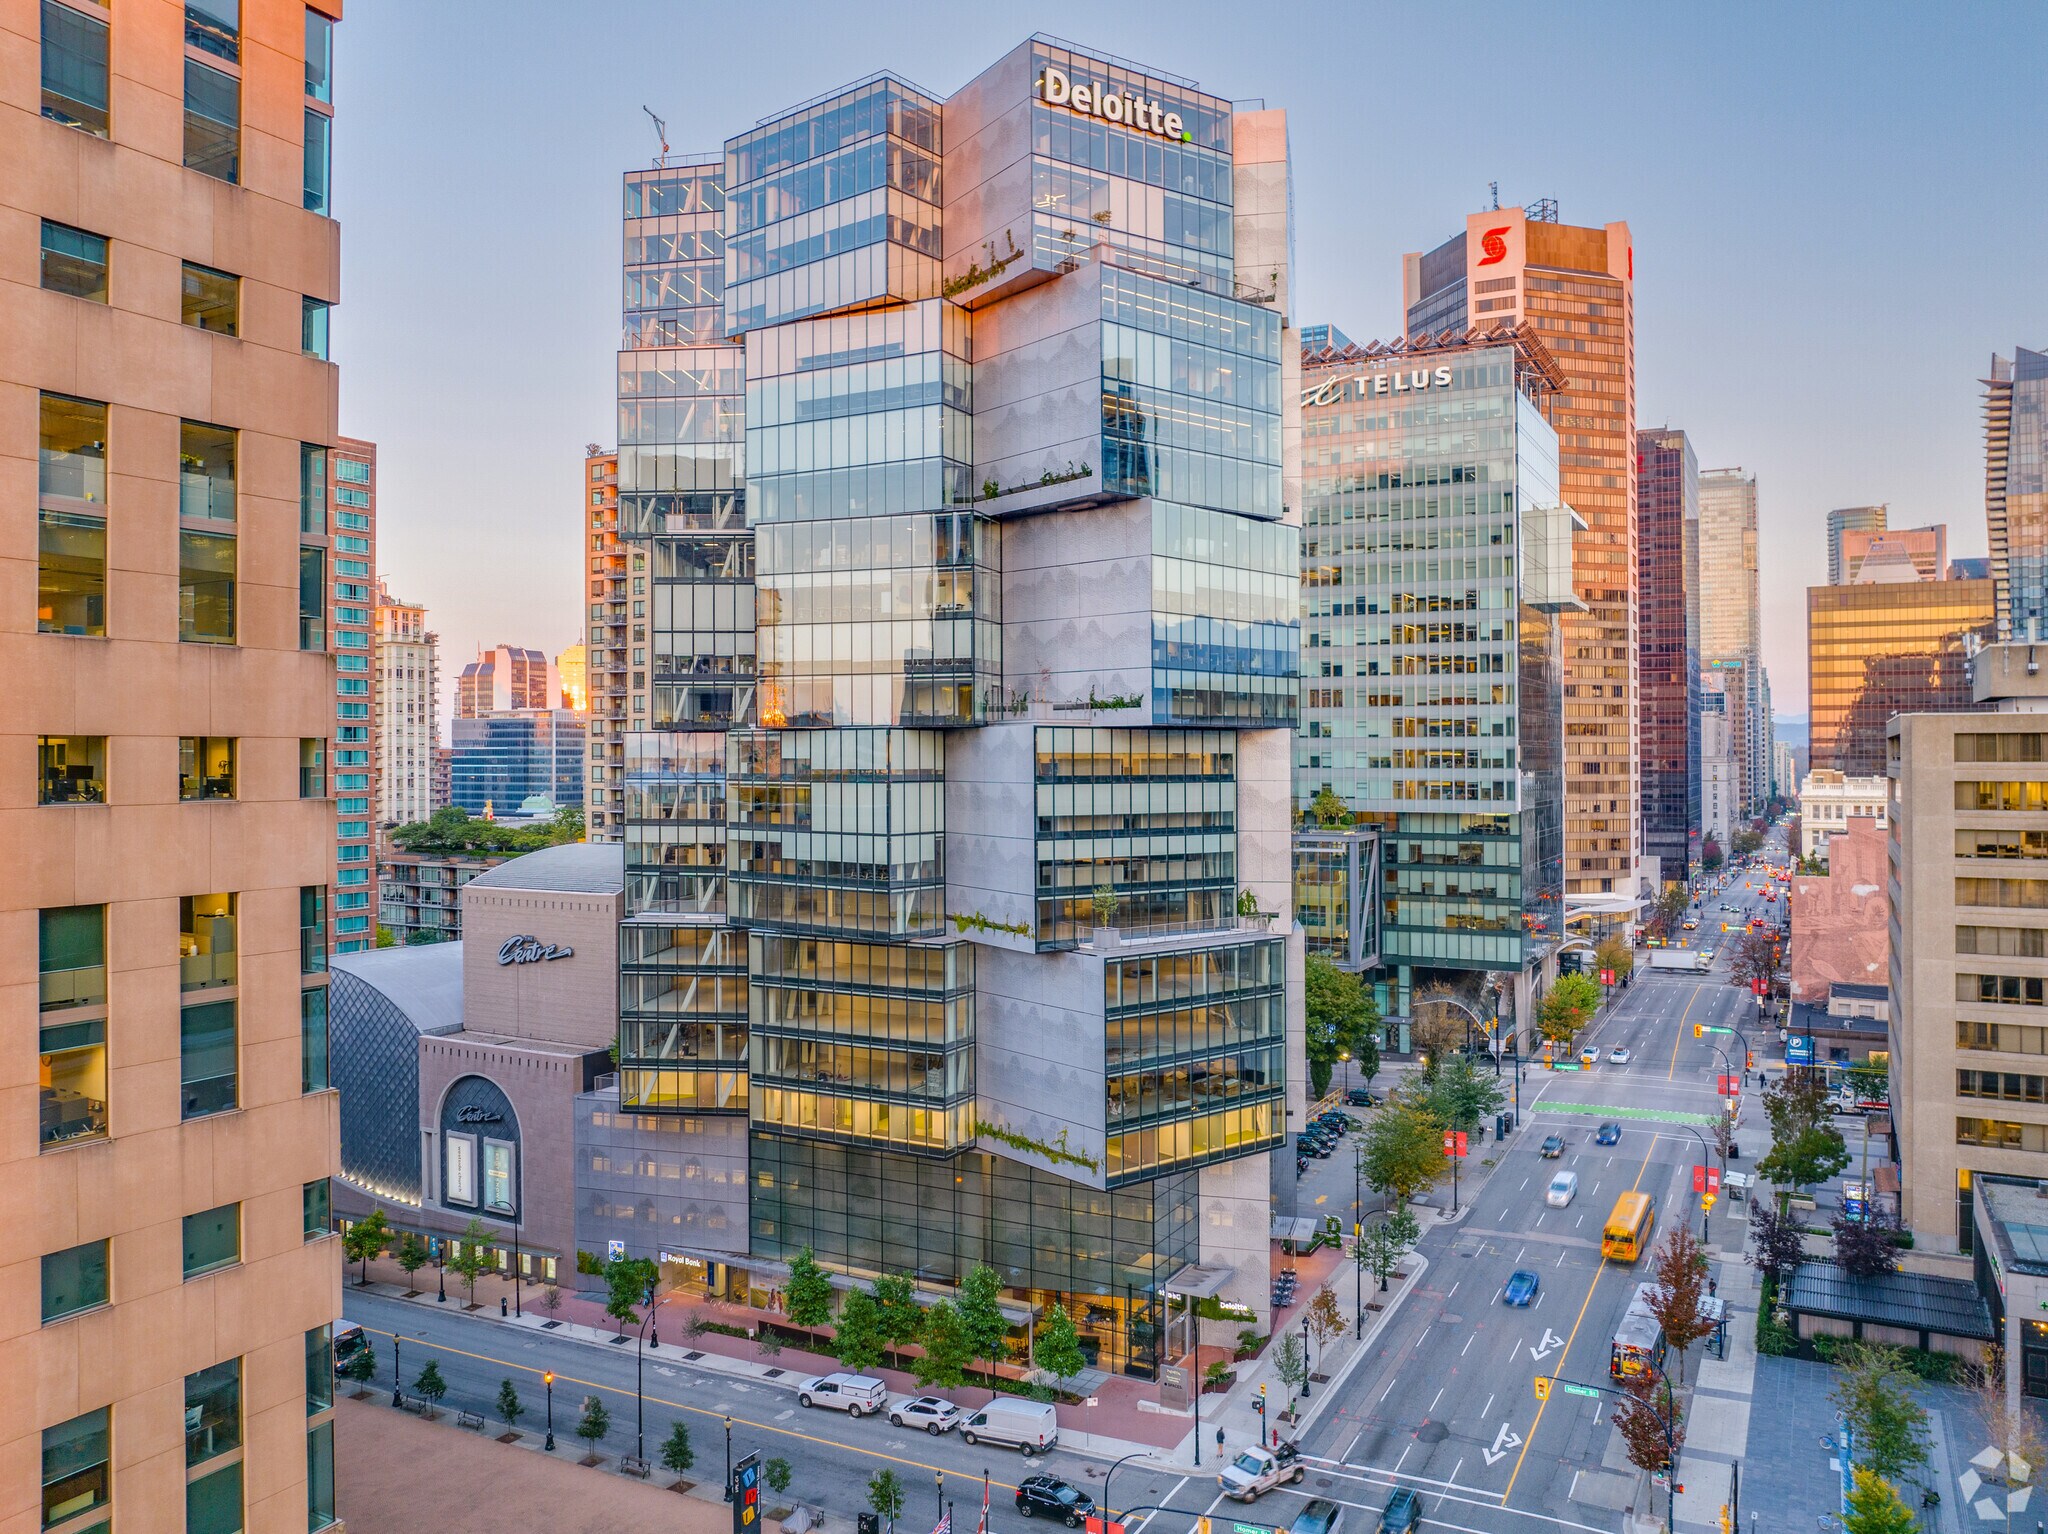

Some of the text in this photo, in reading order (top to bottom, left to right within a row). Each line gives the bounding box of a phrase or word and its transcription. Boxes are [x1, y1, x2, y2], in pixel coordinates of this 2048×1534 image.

[1353, 366, 1452, 395] TELUS
[498, 935, 574, 965] Centre
[667, 1254, 684, 1265] Royal
[685, 1257, 701, 1267] Bank
[1567, 1386, 1586, 1394] Homer
[1236, 1525, 1258, 1534] Homer
